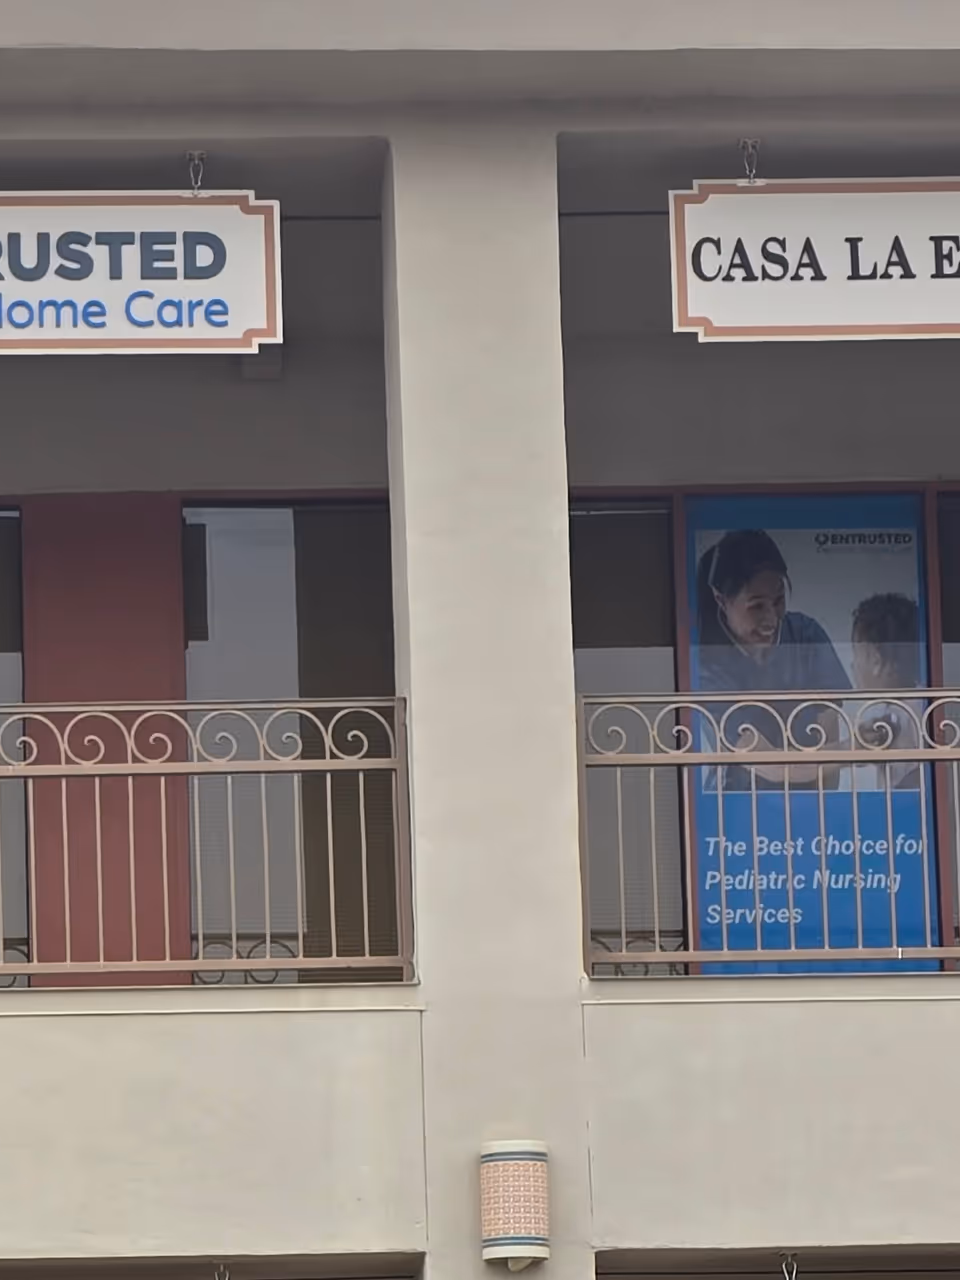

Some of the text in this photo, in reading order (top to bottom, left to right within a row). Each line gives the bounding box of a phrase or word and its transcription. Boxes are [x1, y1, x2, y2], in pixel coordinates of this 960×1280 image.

[691, 236, 827, 282] CASA
[844, 235, 917, 281] LA
[125, 290, 231, 328] Care
[831, 532, 912, 545] ENTRUSTED
[705, 833, 927, 856] The Best Choice for
[705, 868, 901, 893] Pediatric Nursing
[706, 904, 803, 924] Services
